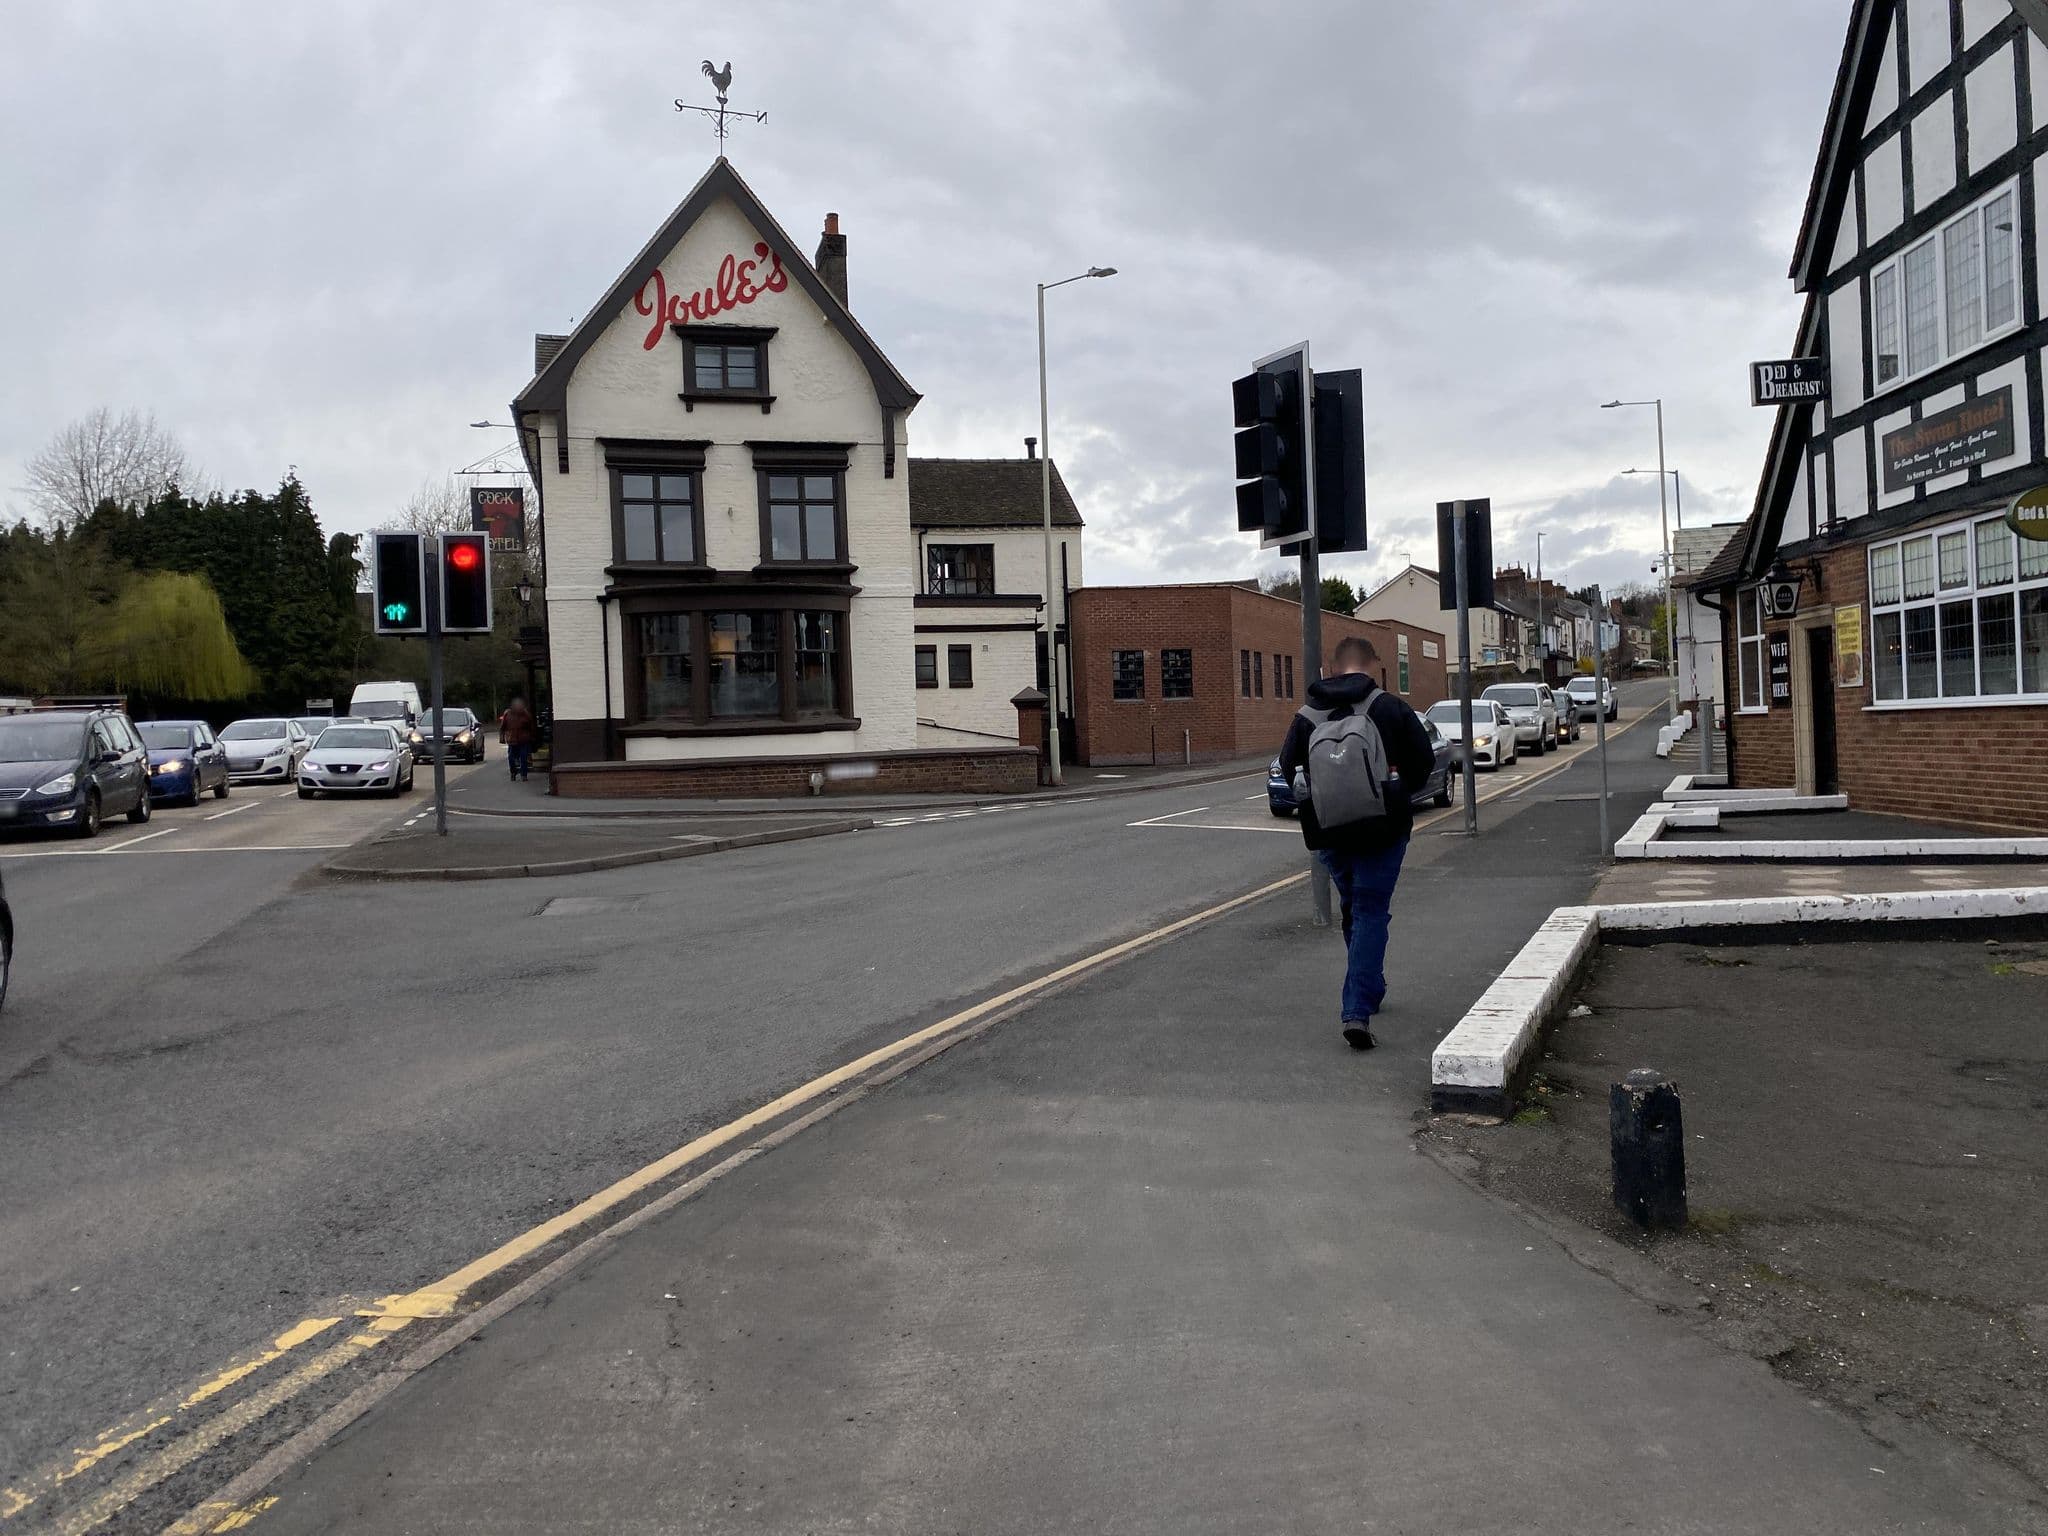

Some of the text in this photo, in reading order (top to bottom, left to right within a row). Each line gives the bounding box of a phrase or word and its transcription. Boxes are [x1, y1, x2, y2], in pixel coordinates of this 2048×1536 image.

[1793, 364, 1801, 378] &
[1759, 372, 1821, 399] BREAKFAST
[477, 490, 514, 505] COCK
[489, 537, 519, 552] OTEL
[1772, 682, 1789, 698] HERE
